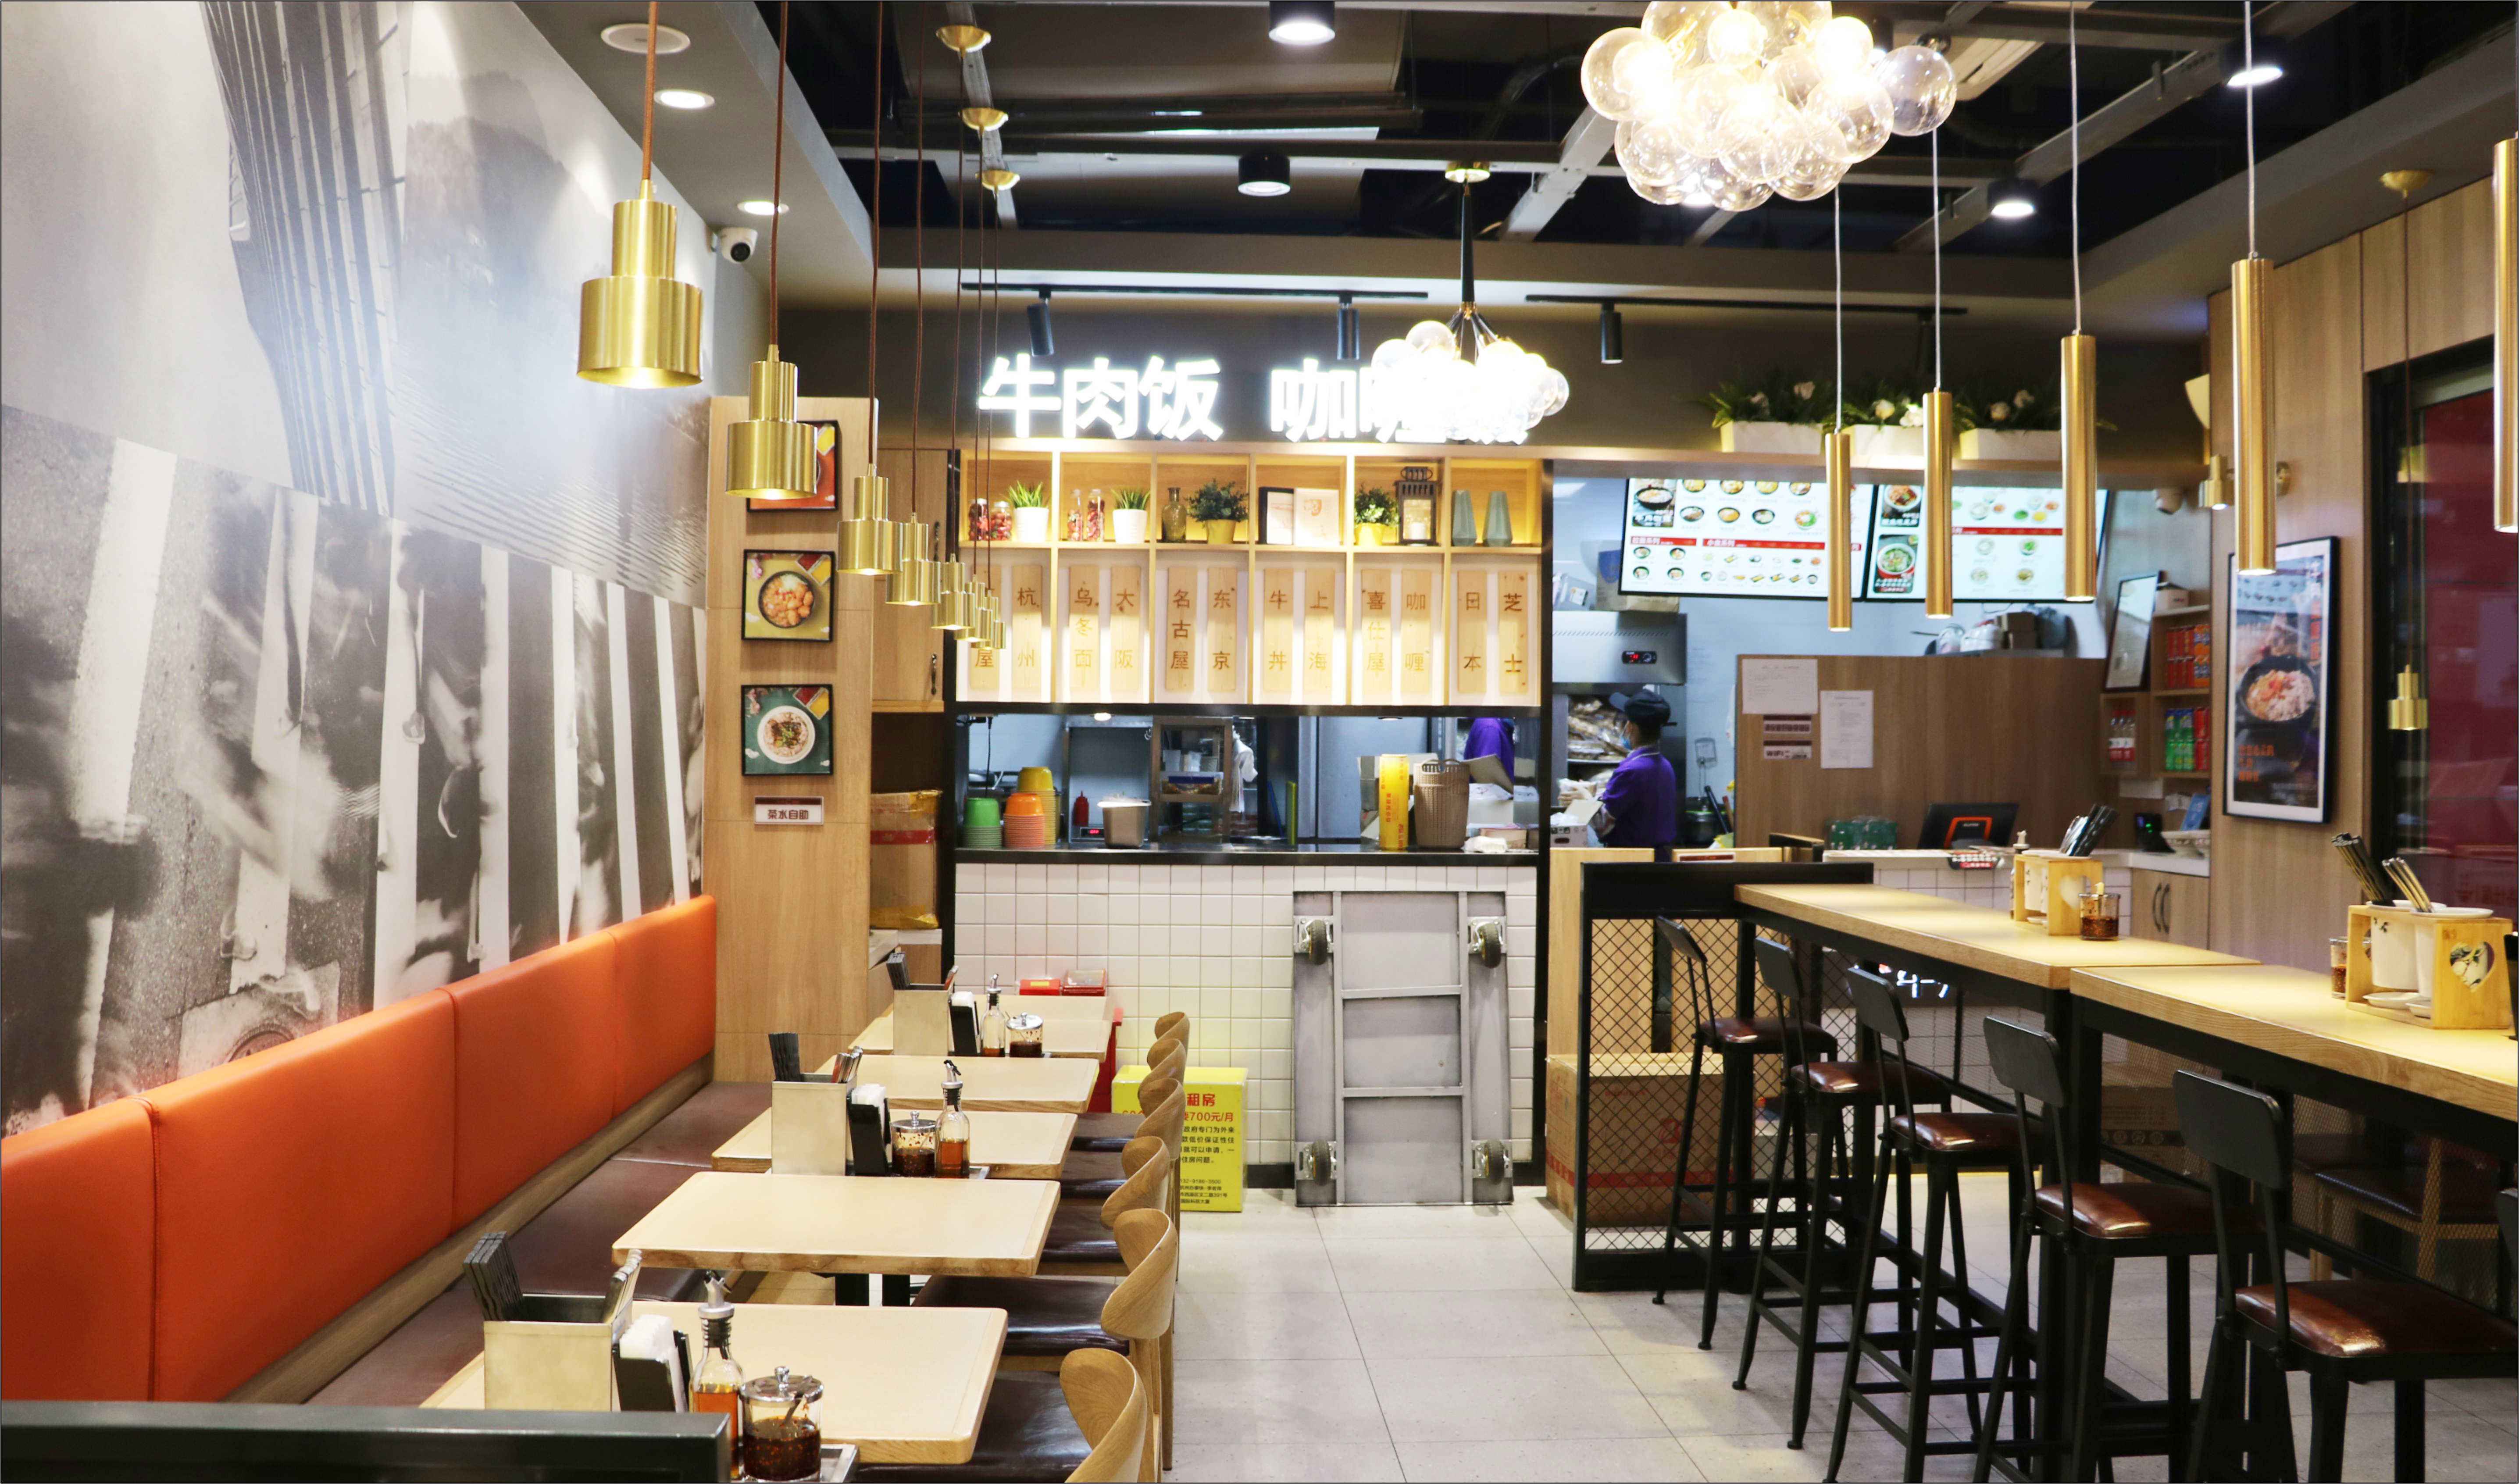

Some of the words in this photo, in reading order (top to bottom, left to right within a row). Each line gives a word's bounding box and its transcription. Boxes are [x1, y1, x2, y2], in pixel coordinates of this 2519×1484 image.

[978, 353, 1224, 441] 牛肉饭
[1017, 587, 1037, 667] 杭州
[1074, 587, 1093, 668] 乌冬面
[1114, 588, 1135, 668] 大阪
[1170, 589, 1191, 670] 名古屋
[1213, 589, 1231, 670] 东京
[1268, 589, 1288, 671] 牛丼
[1309, 590, 1329, 671] 上海
[1405, 592, 1426, 671] 咖喱
[1463, 592, 1482, 672] 日本
[1503, 592, 1523, 674] 芝士
[768, 809, 809, 820] 茶水自助
